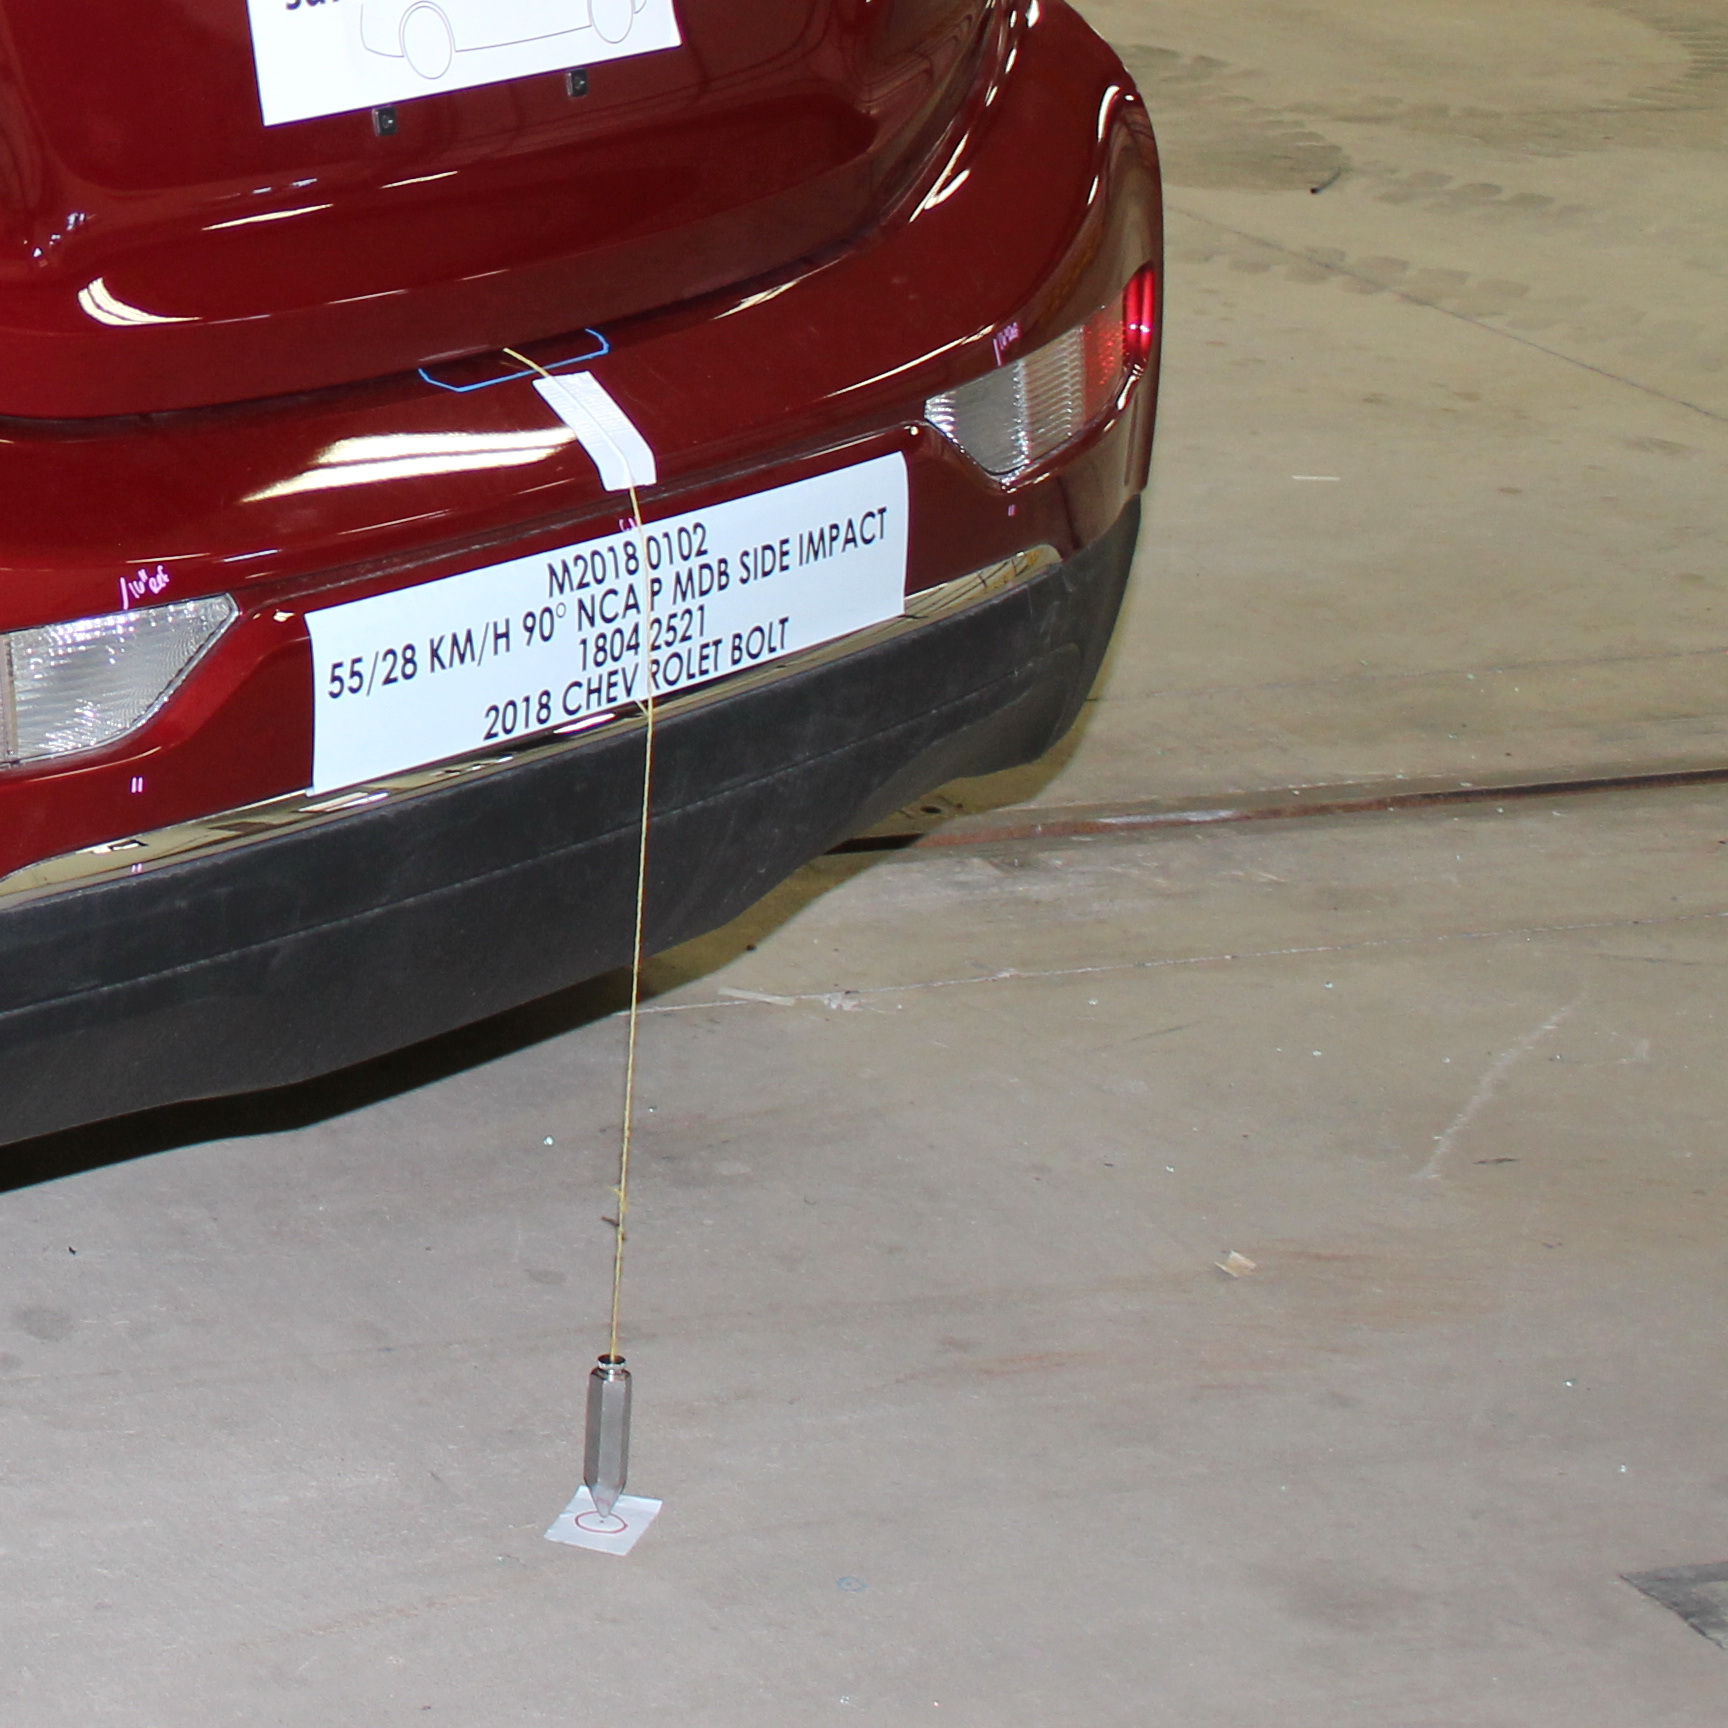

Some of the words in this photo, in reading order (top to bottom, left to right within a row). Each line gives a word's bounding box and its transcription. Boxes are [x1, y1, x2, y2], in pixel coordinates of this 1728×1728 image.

[329, 643, 417, 700] 55/28
[430, 617, 511, 674] KM/H
[673, 557, 730, 606] MDB
[739, 537, 790, 585] SIDE
[799, 506, 888, 567] IMPACT
[483, 689, 552, 742] 2018
[731, 617, 790, 668] BOLT
